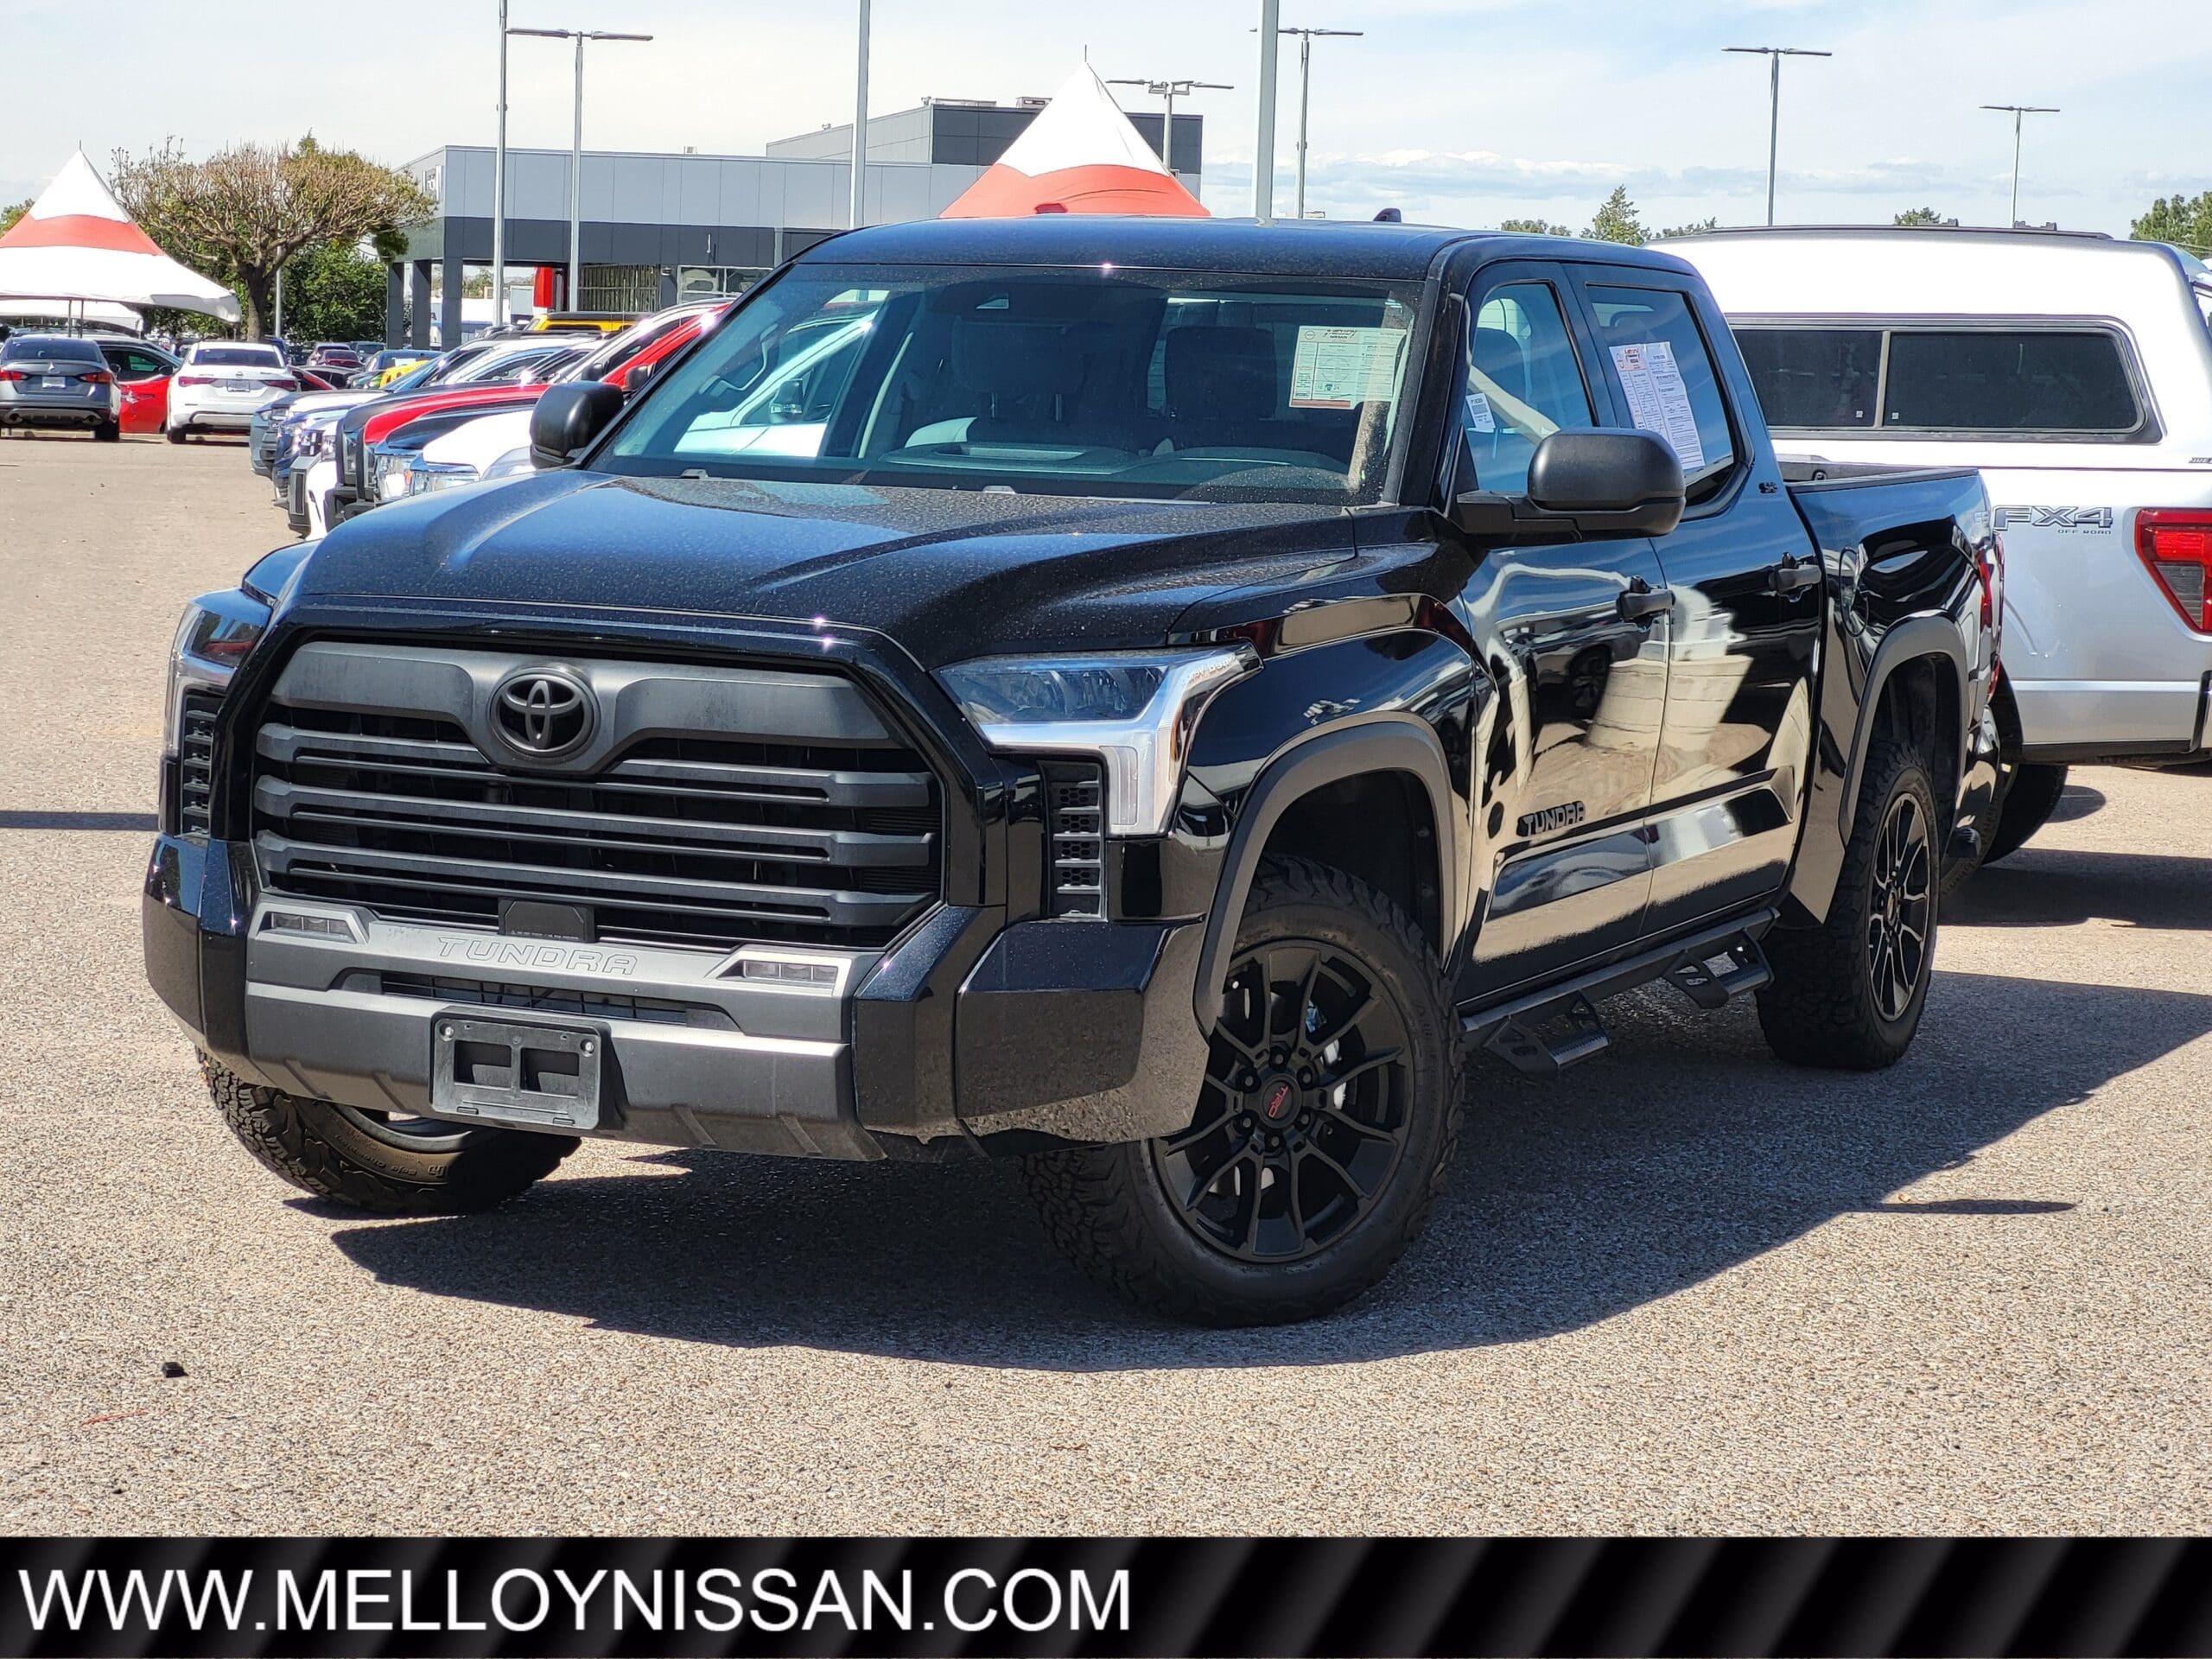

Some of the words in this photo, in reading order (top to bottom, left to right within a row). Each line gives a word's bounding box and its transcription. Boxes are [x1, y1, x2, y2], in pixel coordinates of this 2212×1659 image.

[1992, 505, 2113, 531] FX4
[1517, 800, 1586, 836] TUNDRA
[438, 936, 638, 976] TUNDRA
[1268, 1085, 1288, 1118] TRD
